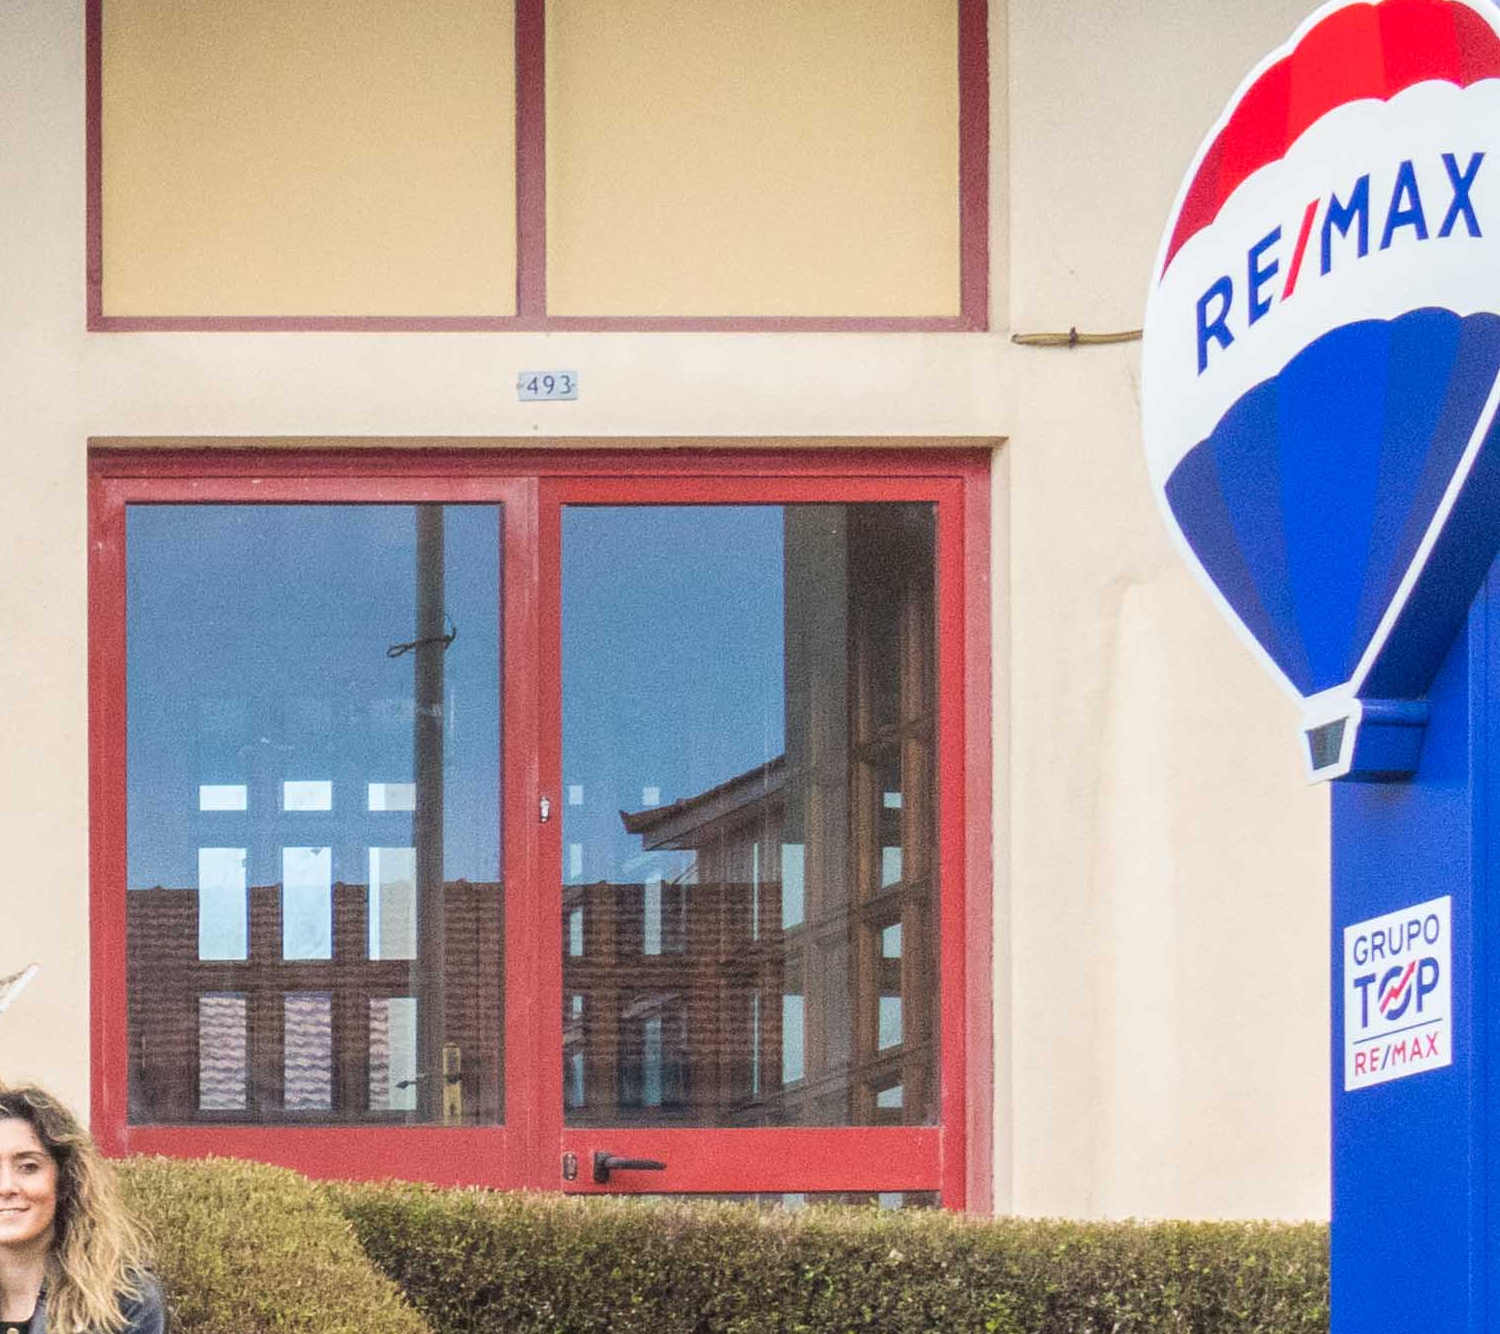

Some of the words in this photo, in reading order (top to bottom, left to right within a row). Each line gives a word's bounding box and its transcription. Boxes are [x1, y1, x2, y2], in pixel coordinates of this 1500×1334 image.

[1196, 152, 1486, 377] RE/MAX
[526, 374, 573, 395] 493
[1353, 913, 1440, 966] GRUPO
[1353, 957, 1440, 1028] TOP
[1354, 1031, 1440, 1077] RE/MAX
